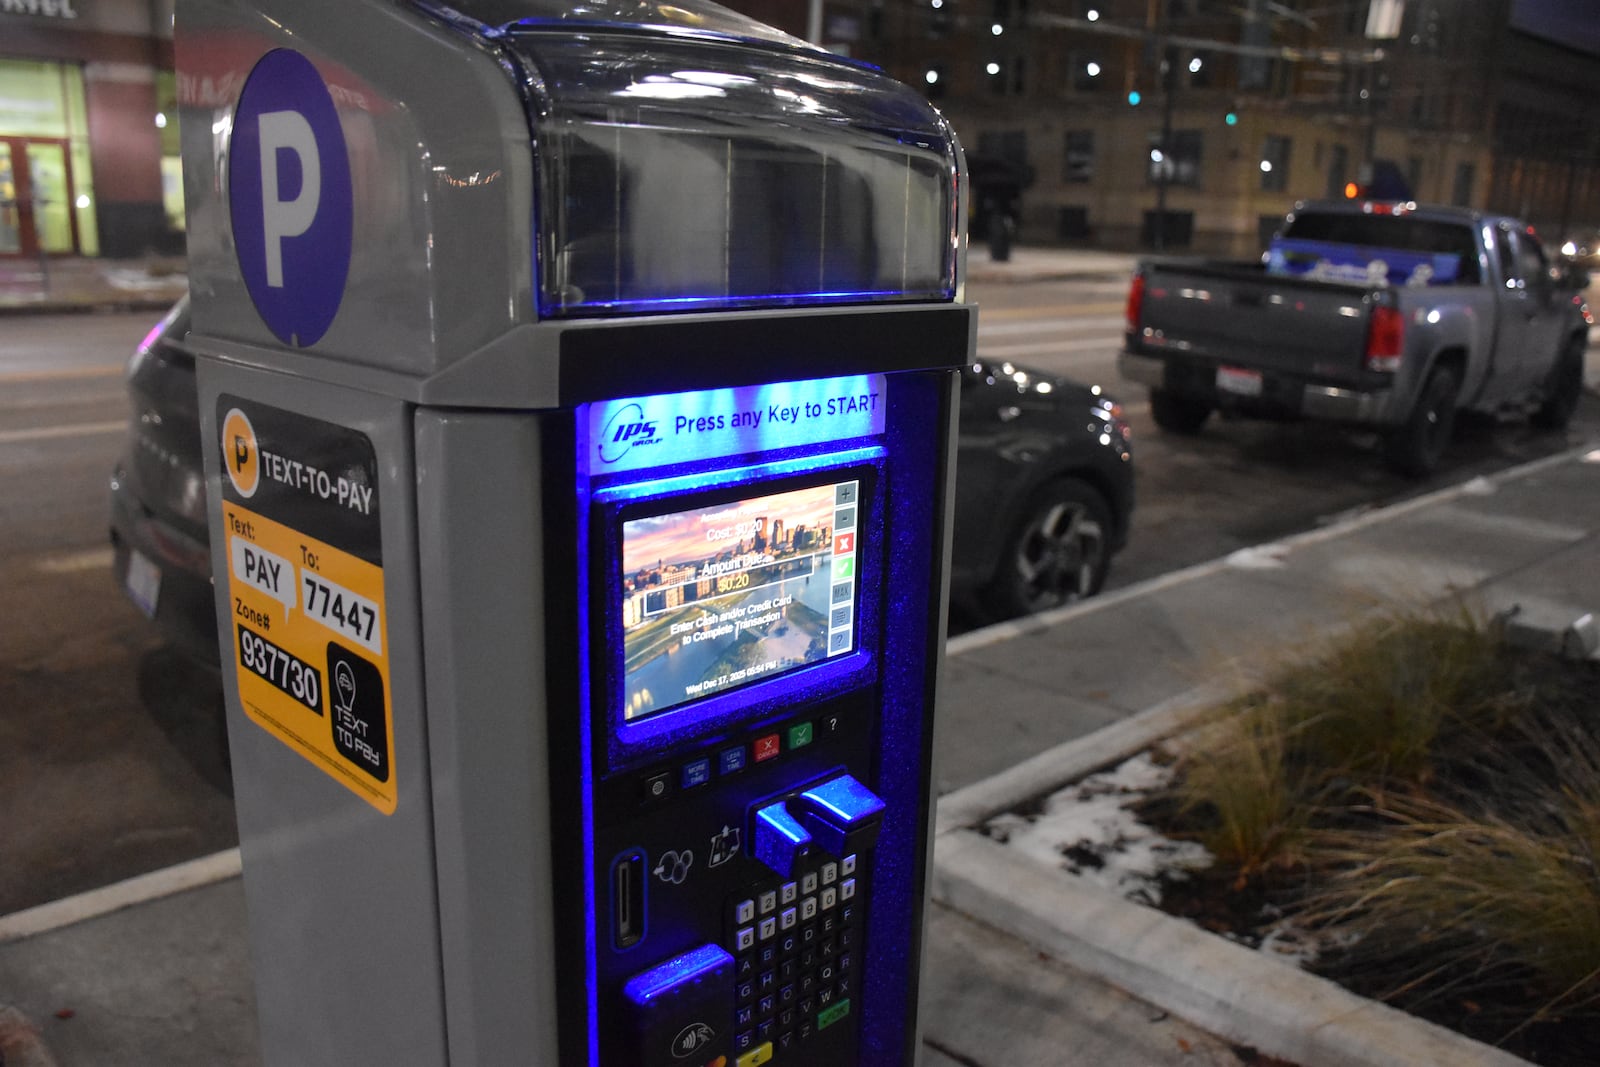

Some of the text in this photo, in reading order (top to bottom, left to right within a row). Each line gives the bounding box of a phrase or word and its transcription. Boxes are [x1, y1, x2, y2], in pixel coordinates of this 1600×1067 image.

[258, 110, 321, 288] P
[612, 421, 657, 442] IPS
[675, 393, 879, 435] Press any Key to START
[235, 435, 248, 474] P
[262, 450, 373, 515] TEXT-TO-PAY
[228, 512, 255, 539] Text:
[244, 547, 281, 592] PAY
[300, 544, 320, 571] To:
[701, 556, 740, 578] Amount
[718, 572, 749, 593] $0.20
[235, 597, 270, 631] Zone#
[305, 577, 375, 641] 77447
[670, 593, 792, 635] Enter Cash and/or Credit Card
[682, 609, 780, 645] to Complete Transaction
[241, 630, 319, 707] 937730
[685, 682, 702, 695] Wed
[703, 677, 717, 690] Dec
[765, 659, 776, 671] PM
[334, 704, 368, 738] TEXT
[743, 869, 833, 918] 1 2 3 4 5
[742, 908, 852, 972] A B C D E F
[743, 933, 751, 945] 6
[765, 923, 773, 935] 7
[786, 912, 793, 924] 8
[807, 904, 814, 915] 9
[826, 895, 833, 905] 0
[740, 1009, 752, 1024] M
[763, 999, 773, 1012] N
[783, 988, 793, 1001] O
[804, 976, 812, 990] P
[841, 956, 850, 970] R
[741, 984, 751, 998] G
[763, 973, 773, 987] H
[805, 953, 811, 965] J
[824, 943, 833, 956] K
[741, 1035, 751, 1048] S
[782, 1012, 791, 1025] U
[803, 1000, 812, 1013] V
[821, 990, 831, 1003] W
[841, 980, 849, 992] X
